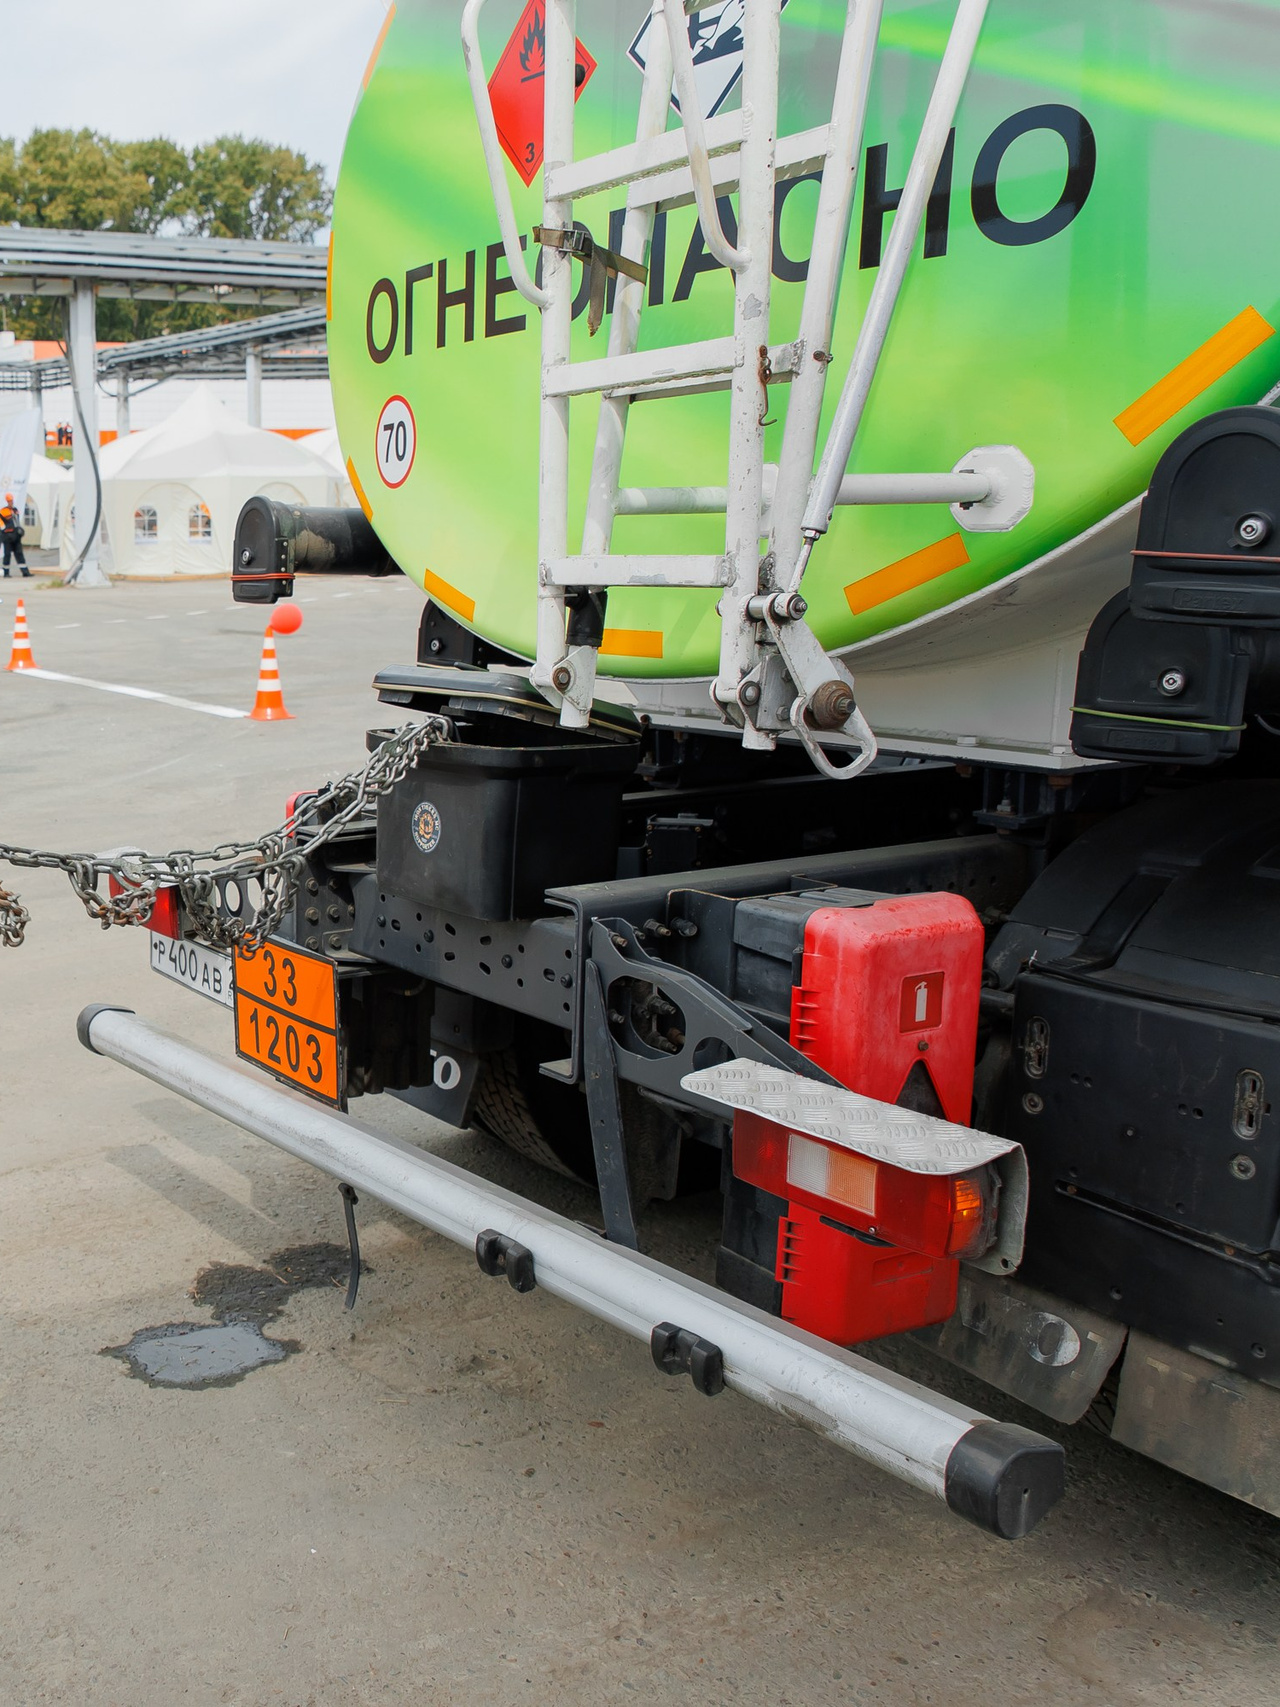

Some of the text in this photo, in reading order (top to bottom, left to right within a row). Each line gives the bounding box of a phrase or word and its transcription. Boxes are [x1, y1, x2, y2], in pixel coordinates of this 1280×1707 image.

[525, 142, 535, 163] 3
[383, 420, 407, 463] 70
[263, 950, 297, 1007] 33
[249, 1007, 323, 1083] 1203
